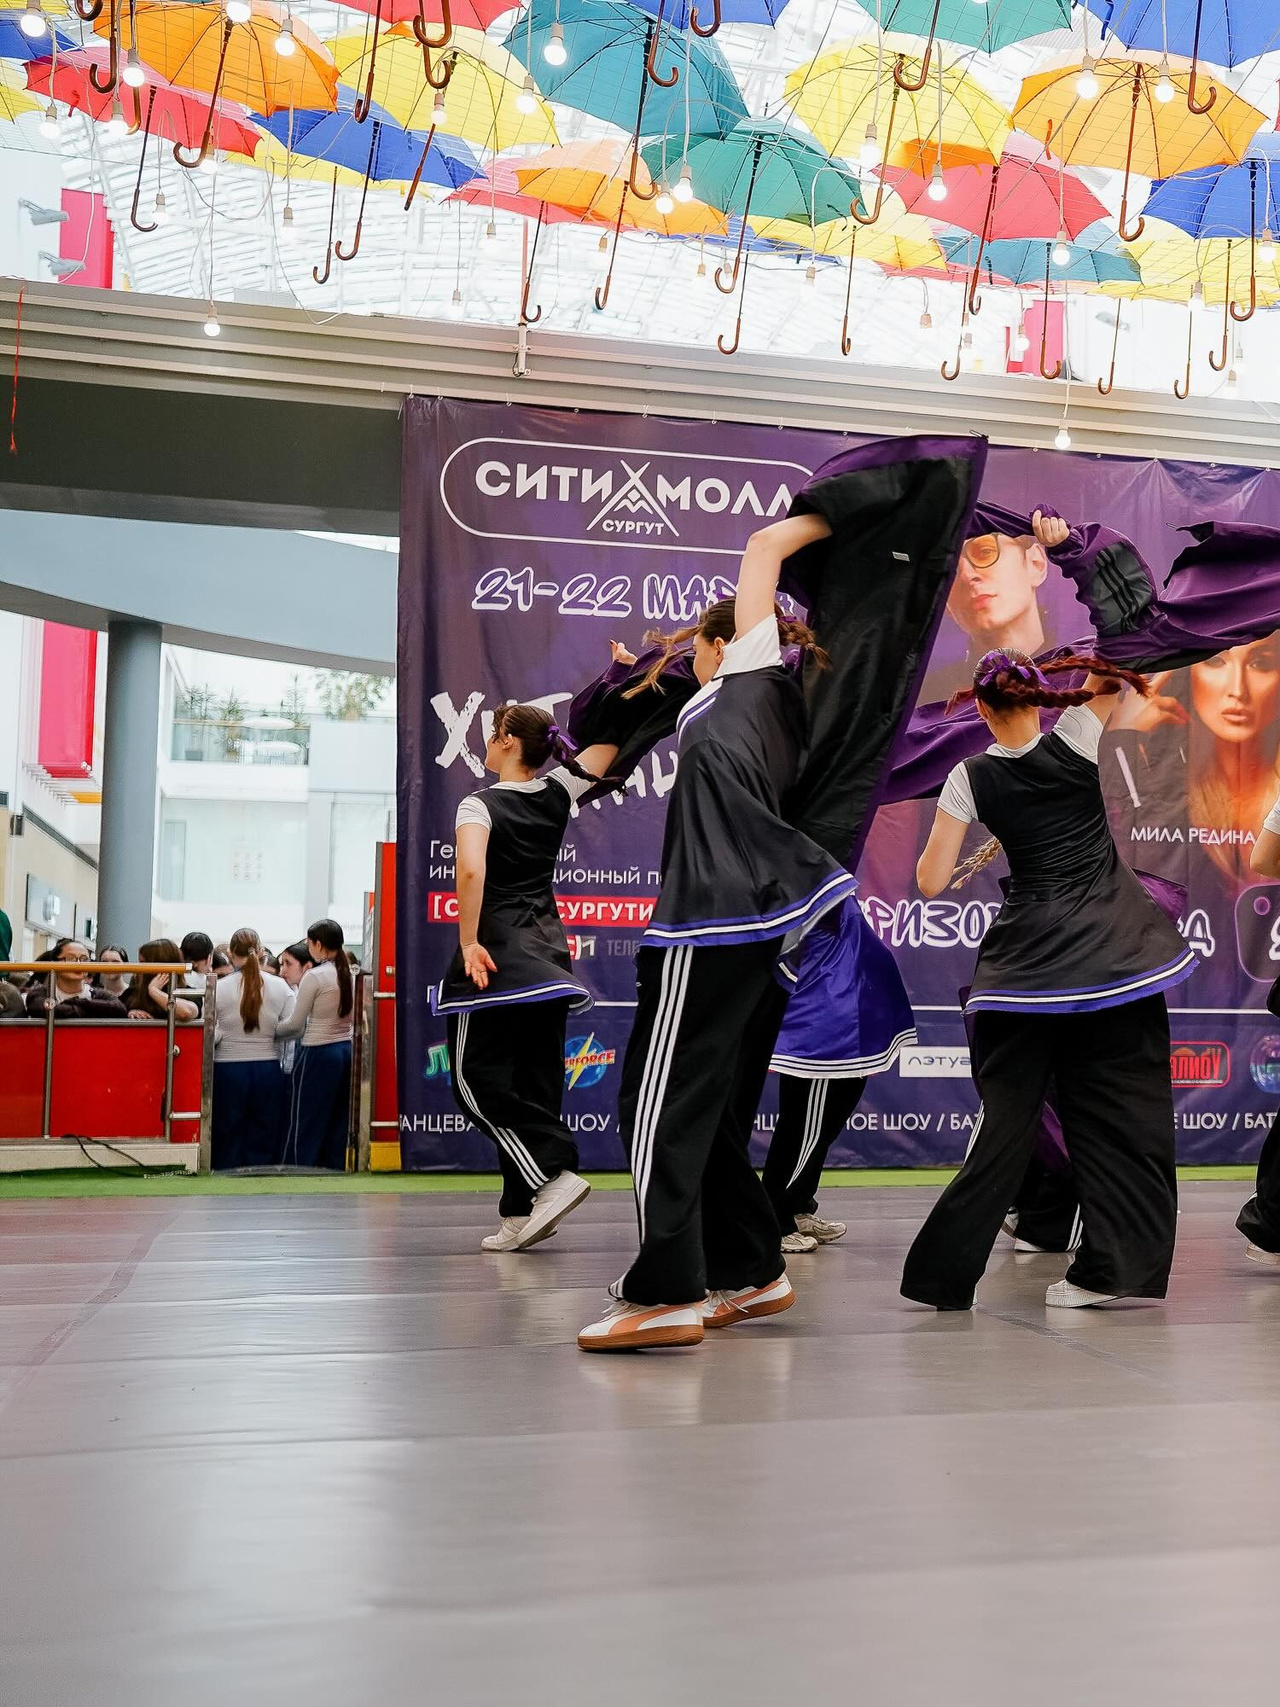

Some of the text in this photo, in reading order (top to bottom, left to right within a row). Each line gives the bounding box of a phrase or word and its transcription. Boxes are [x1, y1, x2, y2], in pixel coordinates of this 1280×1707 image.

[475, 460, 613, 503] СИТИ
[602, 519, 664, 535] СУРГУТ
[471, 567, 633, 619] 21-22
[1130, 826, 1257, 846] МИЛА РЕДИНА
[883, 1113, 932, 1131] ШОУ
[1182, 1112, 1229, 1131] ШОУ
